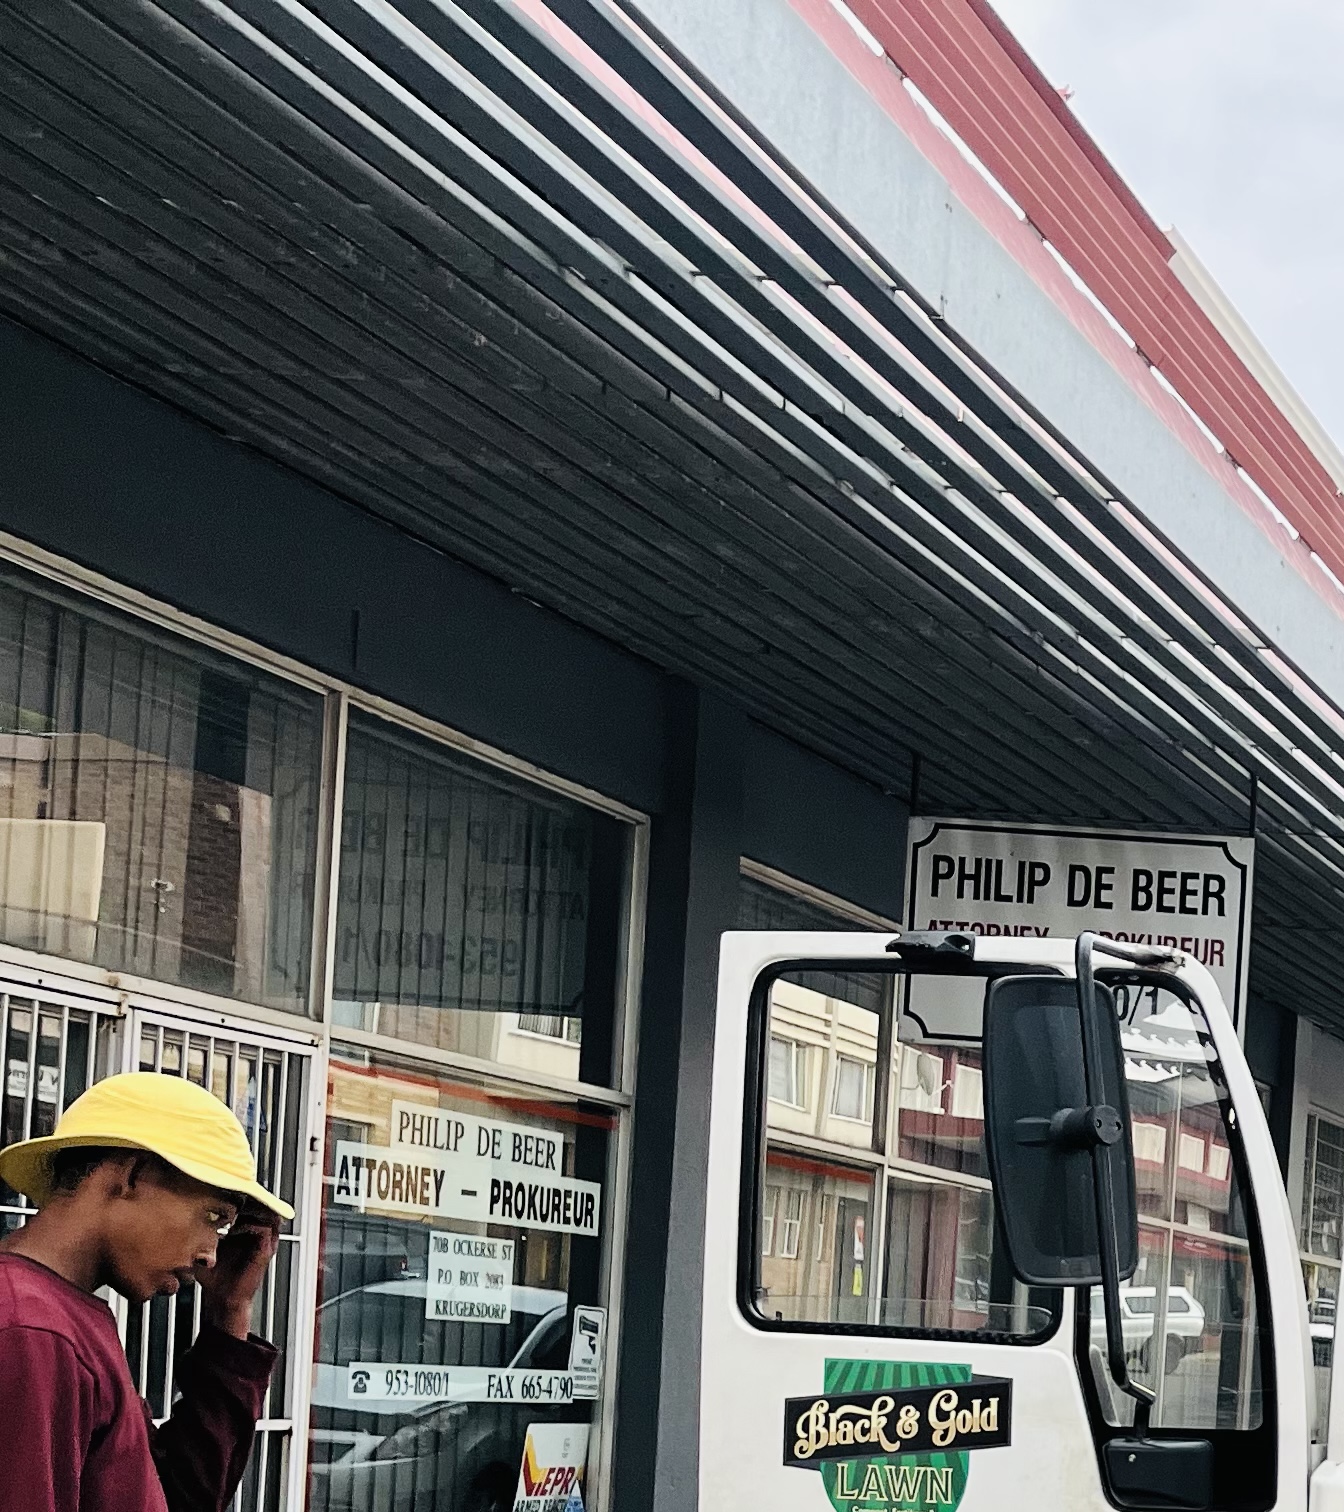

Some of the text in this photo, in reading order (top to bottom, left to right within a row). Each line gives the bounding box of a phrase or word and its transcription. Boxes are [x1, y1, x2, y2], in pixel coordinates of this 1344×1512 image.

[931, 854, 1226, 916] PHILIP DE BEER
[398, 1111, 557, 1171] PHILIP DE BEER
[336, 1155, 446, 1208] ATTORNEY
[489, 1178, 596, 1229] PROKUREUR
[453, 1239, 498, 1259] OCKERSE
[502, 1245, 513, 1260] ST
[460, 1270, 479, 1287] BOX
[435, 1300, 507, 1319] KRUGERSDORP
[386, 1369, 573, 1399] 953-1080/1 FAX 665-4790
[794, 1389, 1000, 1459] Black & Gold
[836, 1462, 954, 1505] LAWN
